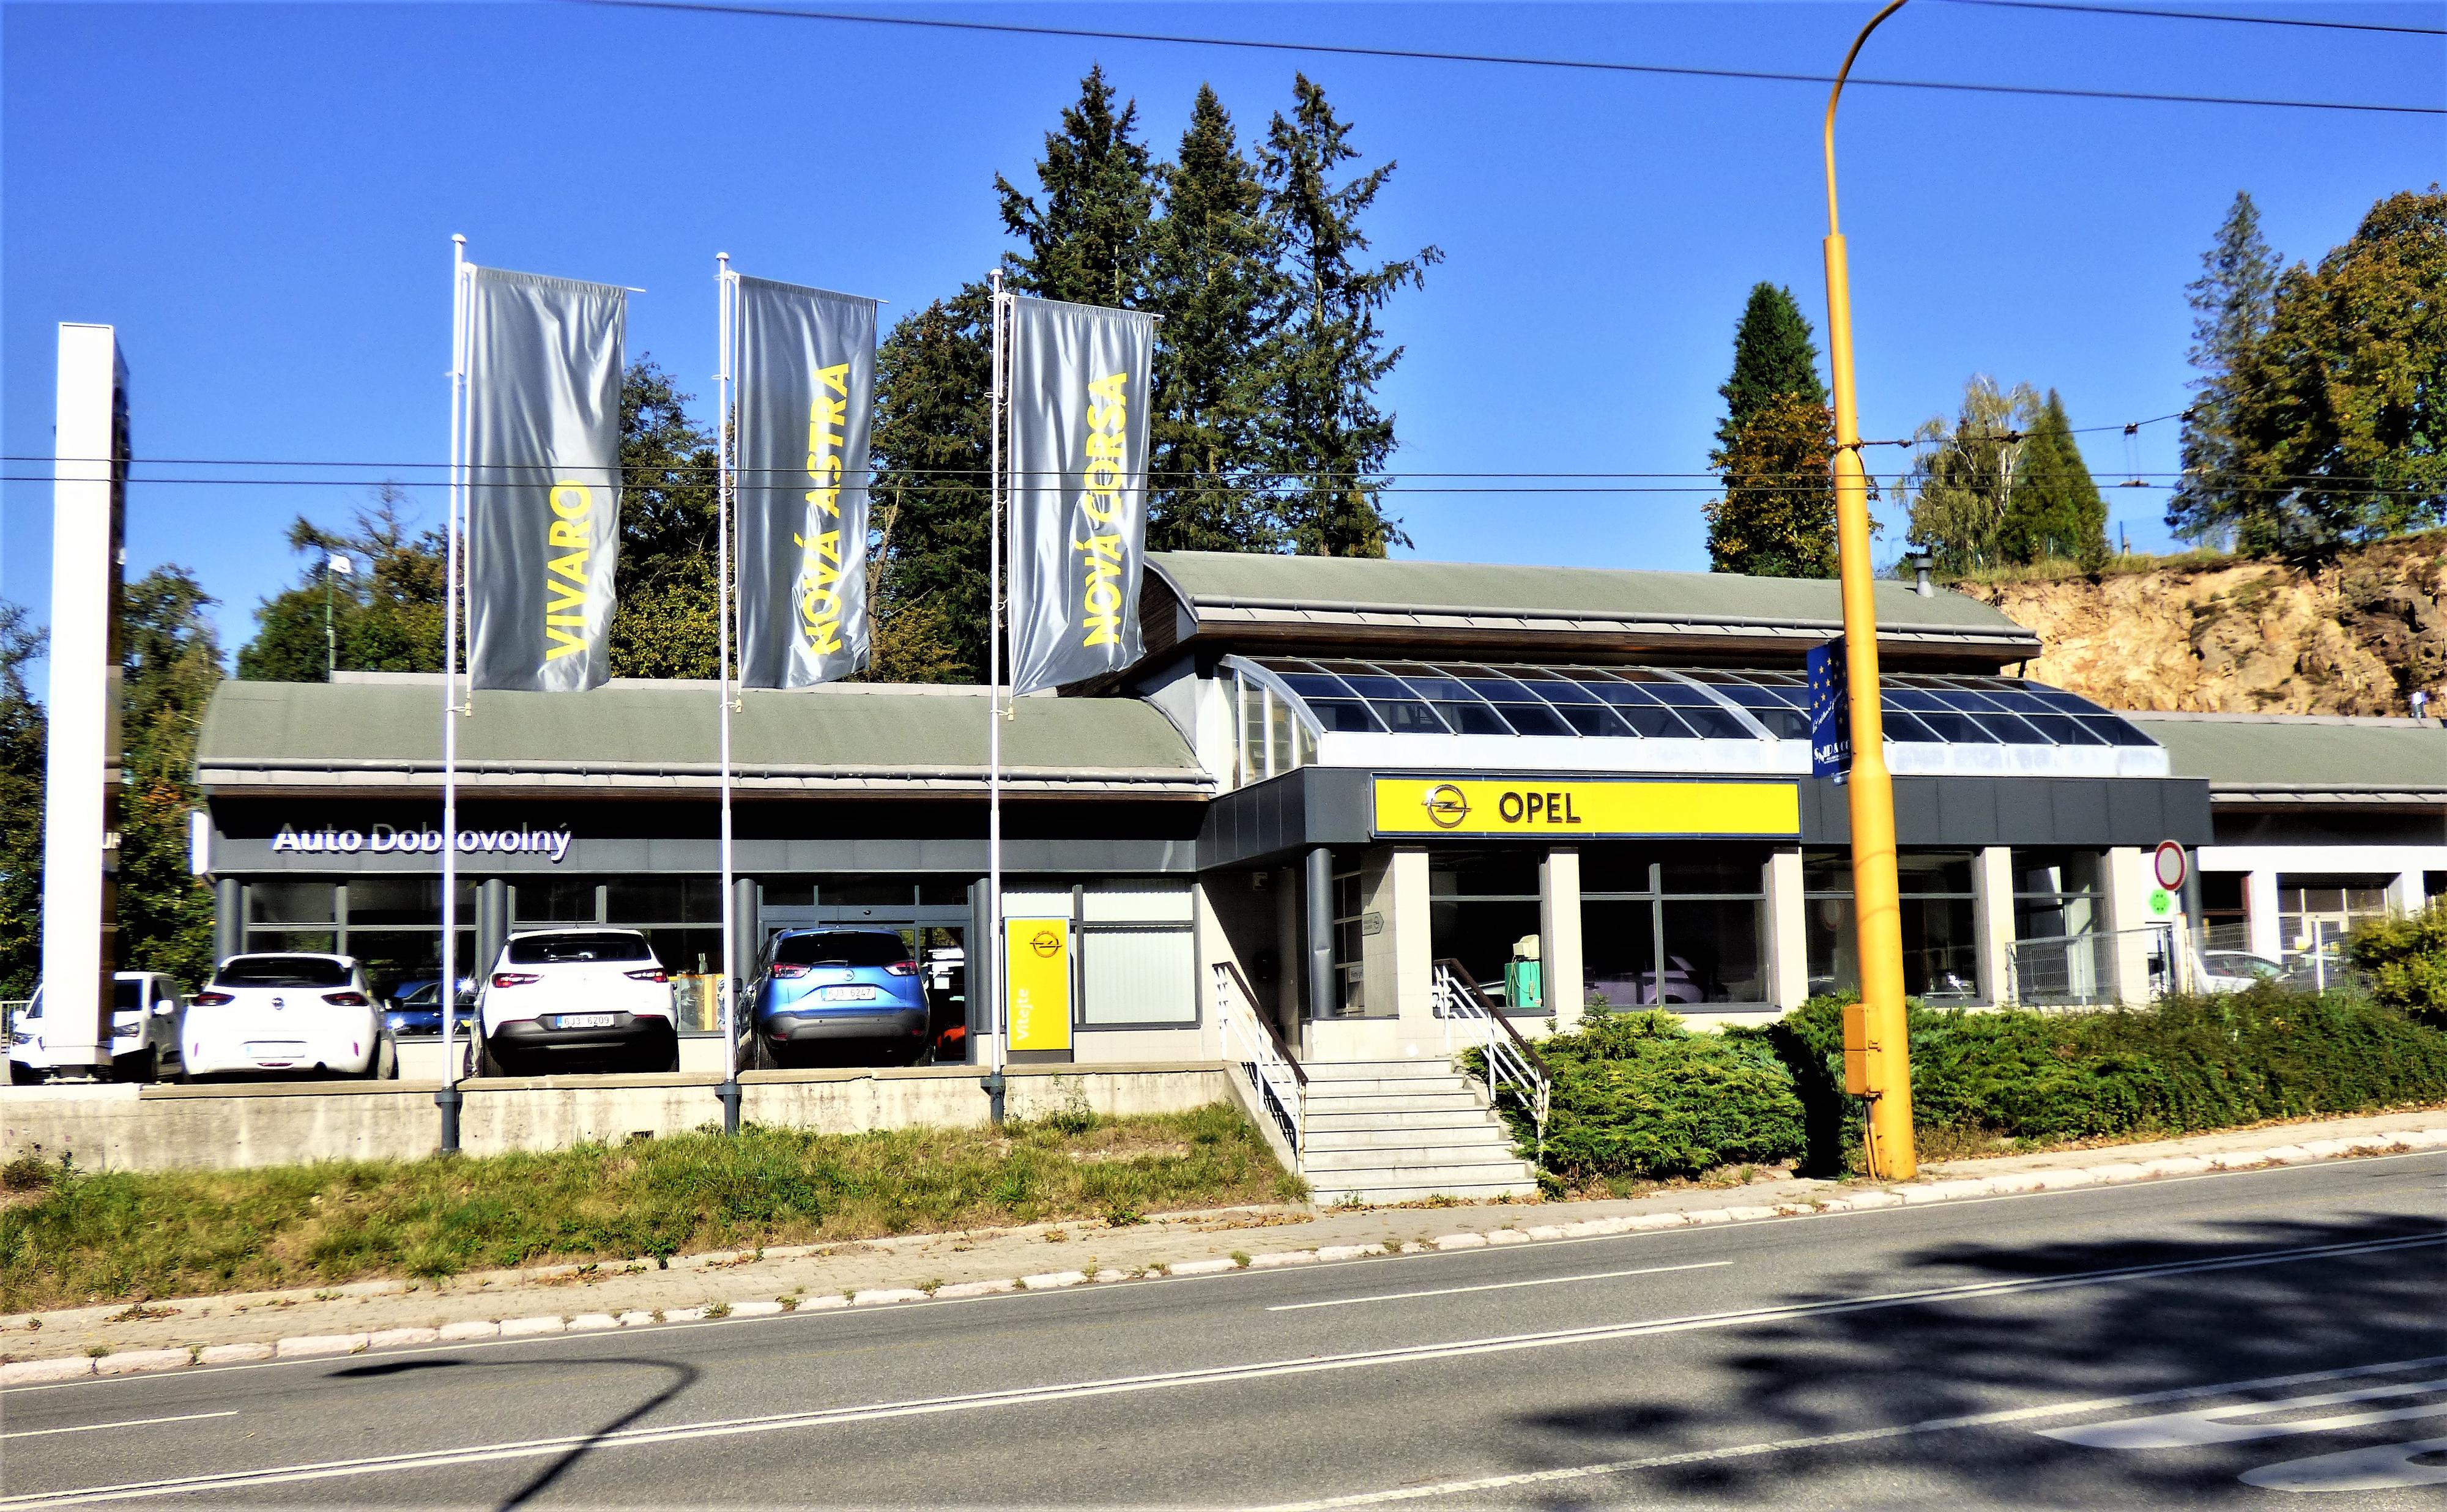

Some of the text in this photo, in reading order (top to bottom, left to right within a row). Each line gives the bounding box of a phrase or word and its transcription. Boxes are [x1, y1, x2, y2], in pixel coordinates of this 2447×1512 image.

[793, 363, 848, 656] NOVÁ ASTRA
[1075, 372, 1127, 647] NOVÁ CORSA
[546, 479, 592, 661] VIVARO
[272, 821, 571, 861] Auto Dobovolný
[1499, 791, 1581, 823] OPEL
[587, 1016, 609, 1025] 6209
